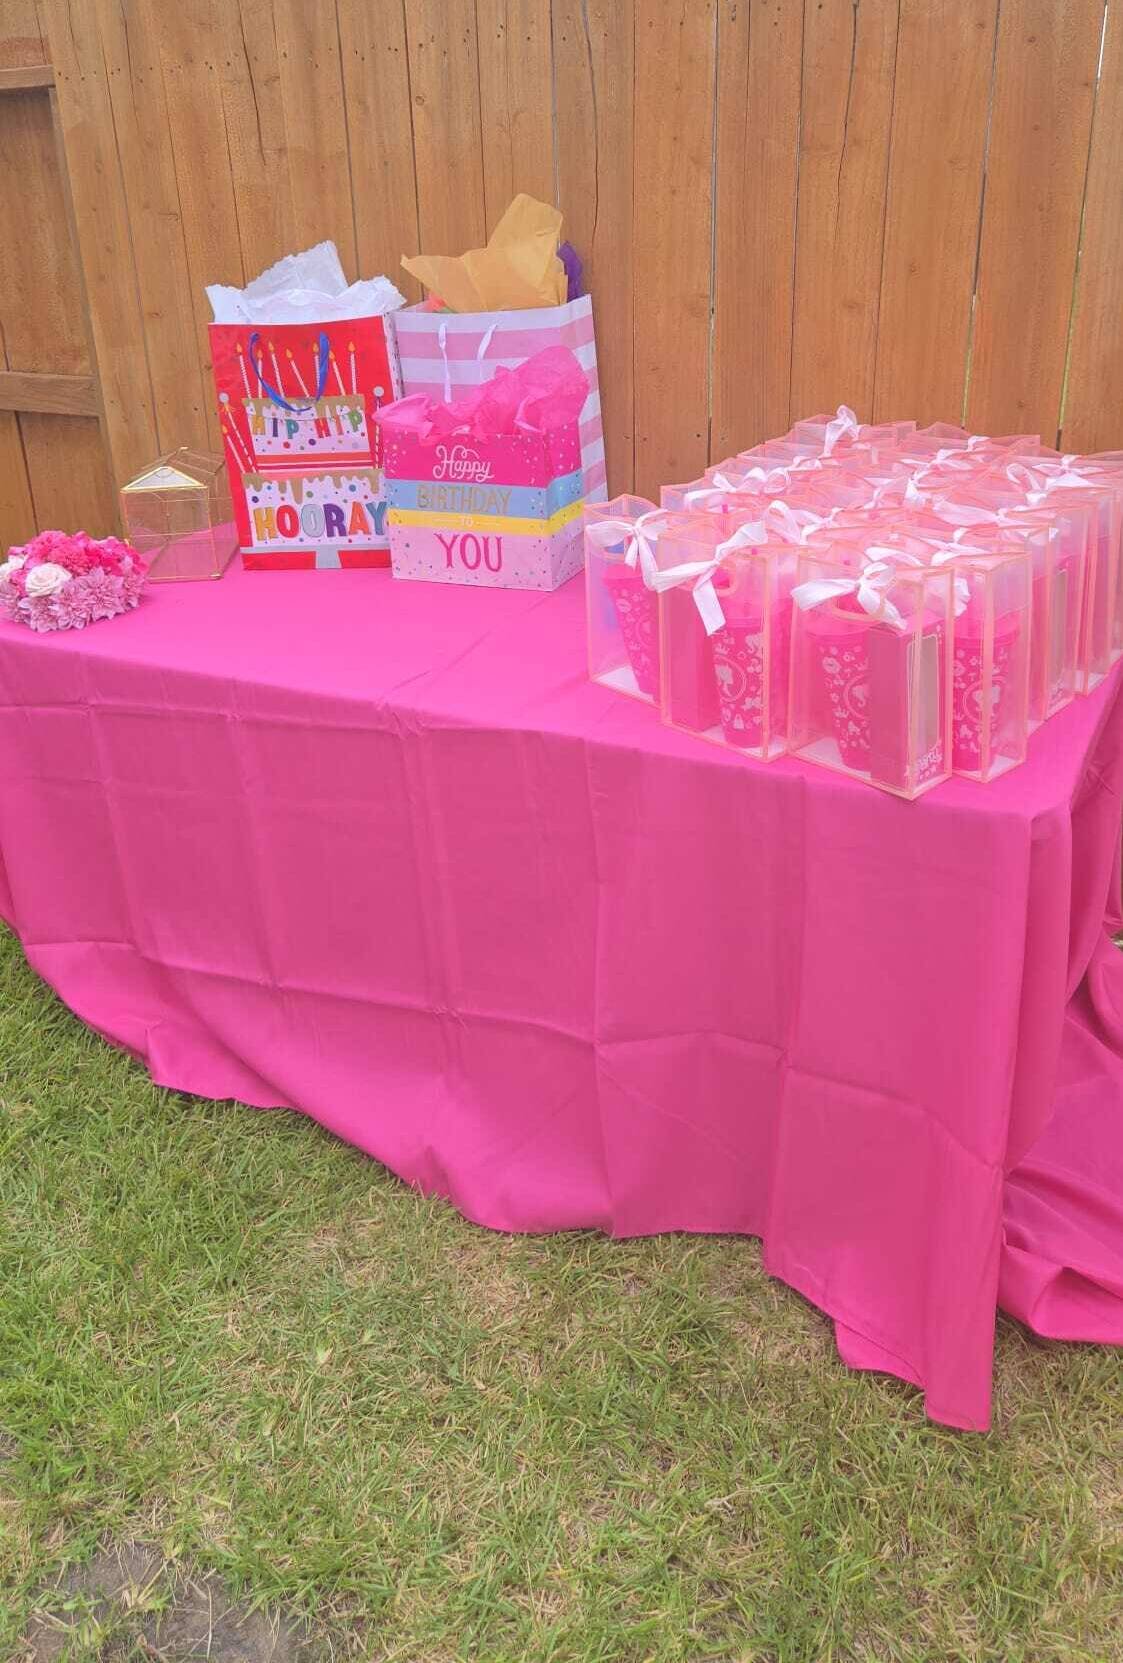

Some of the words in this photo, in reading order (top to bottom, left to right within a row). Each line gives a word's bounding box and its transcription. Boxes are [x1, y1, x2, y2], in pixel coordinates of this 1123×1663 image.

[252, 415, 299, 439] HIP
[314, 409, 363, 438] HIP
[432, 445, 495, 483] Happy
[416, 484, 512, 516] BIRTHDAY
[253, 501, 387, 541] HOORAY
[433, 533, 503, 572] YOU
